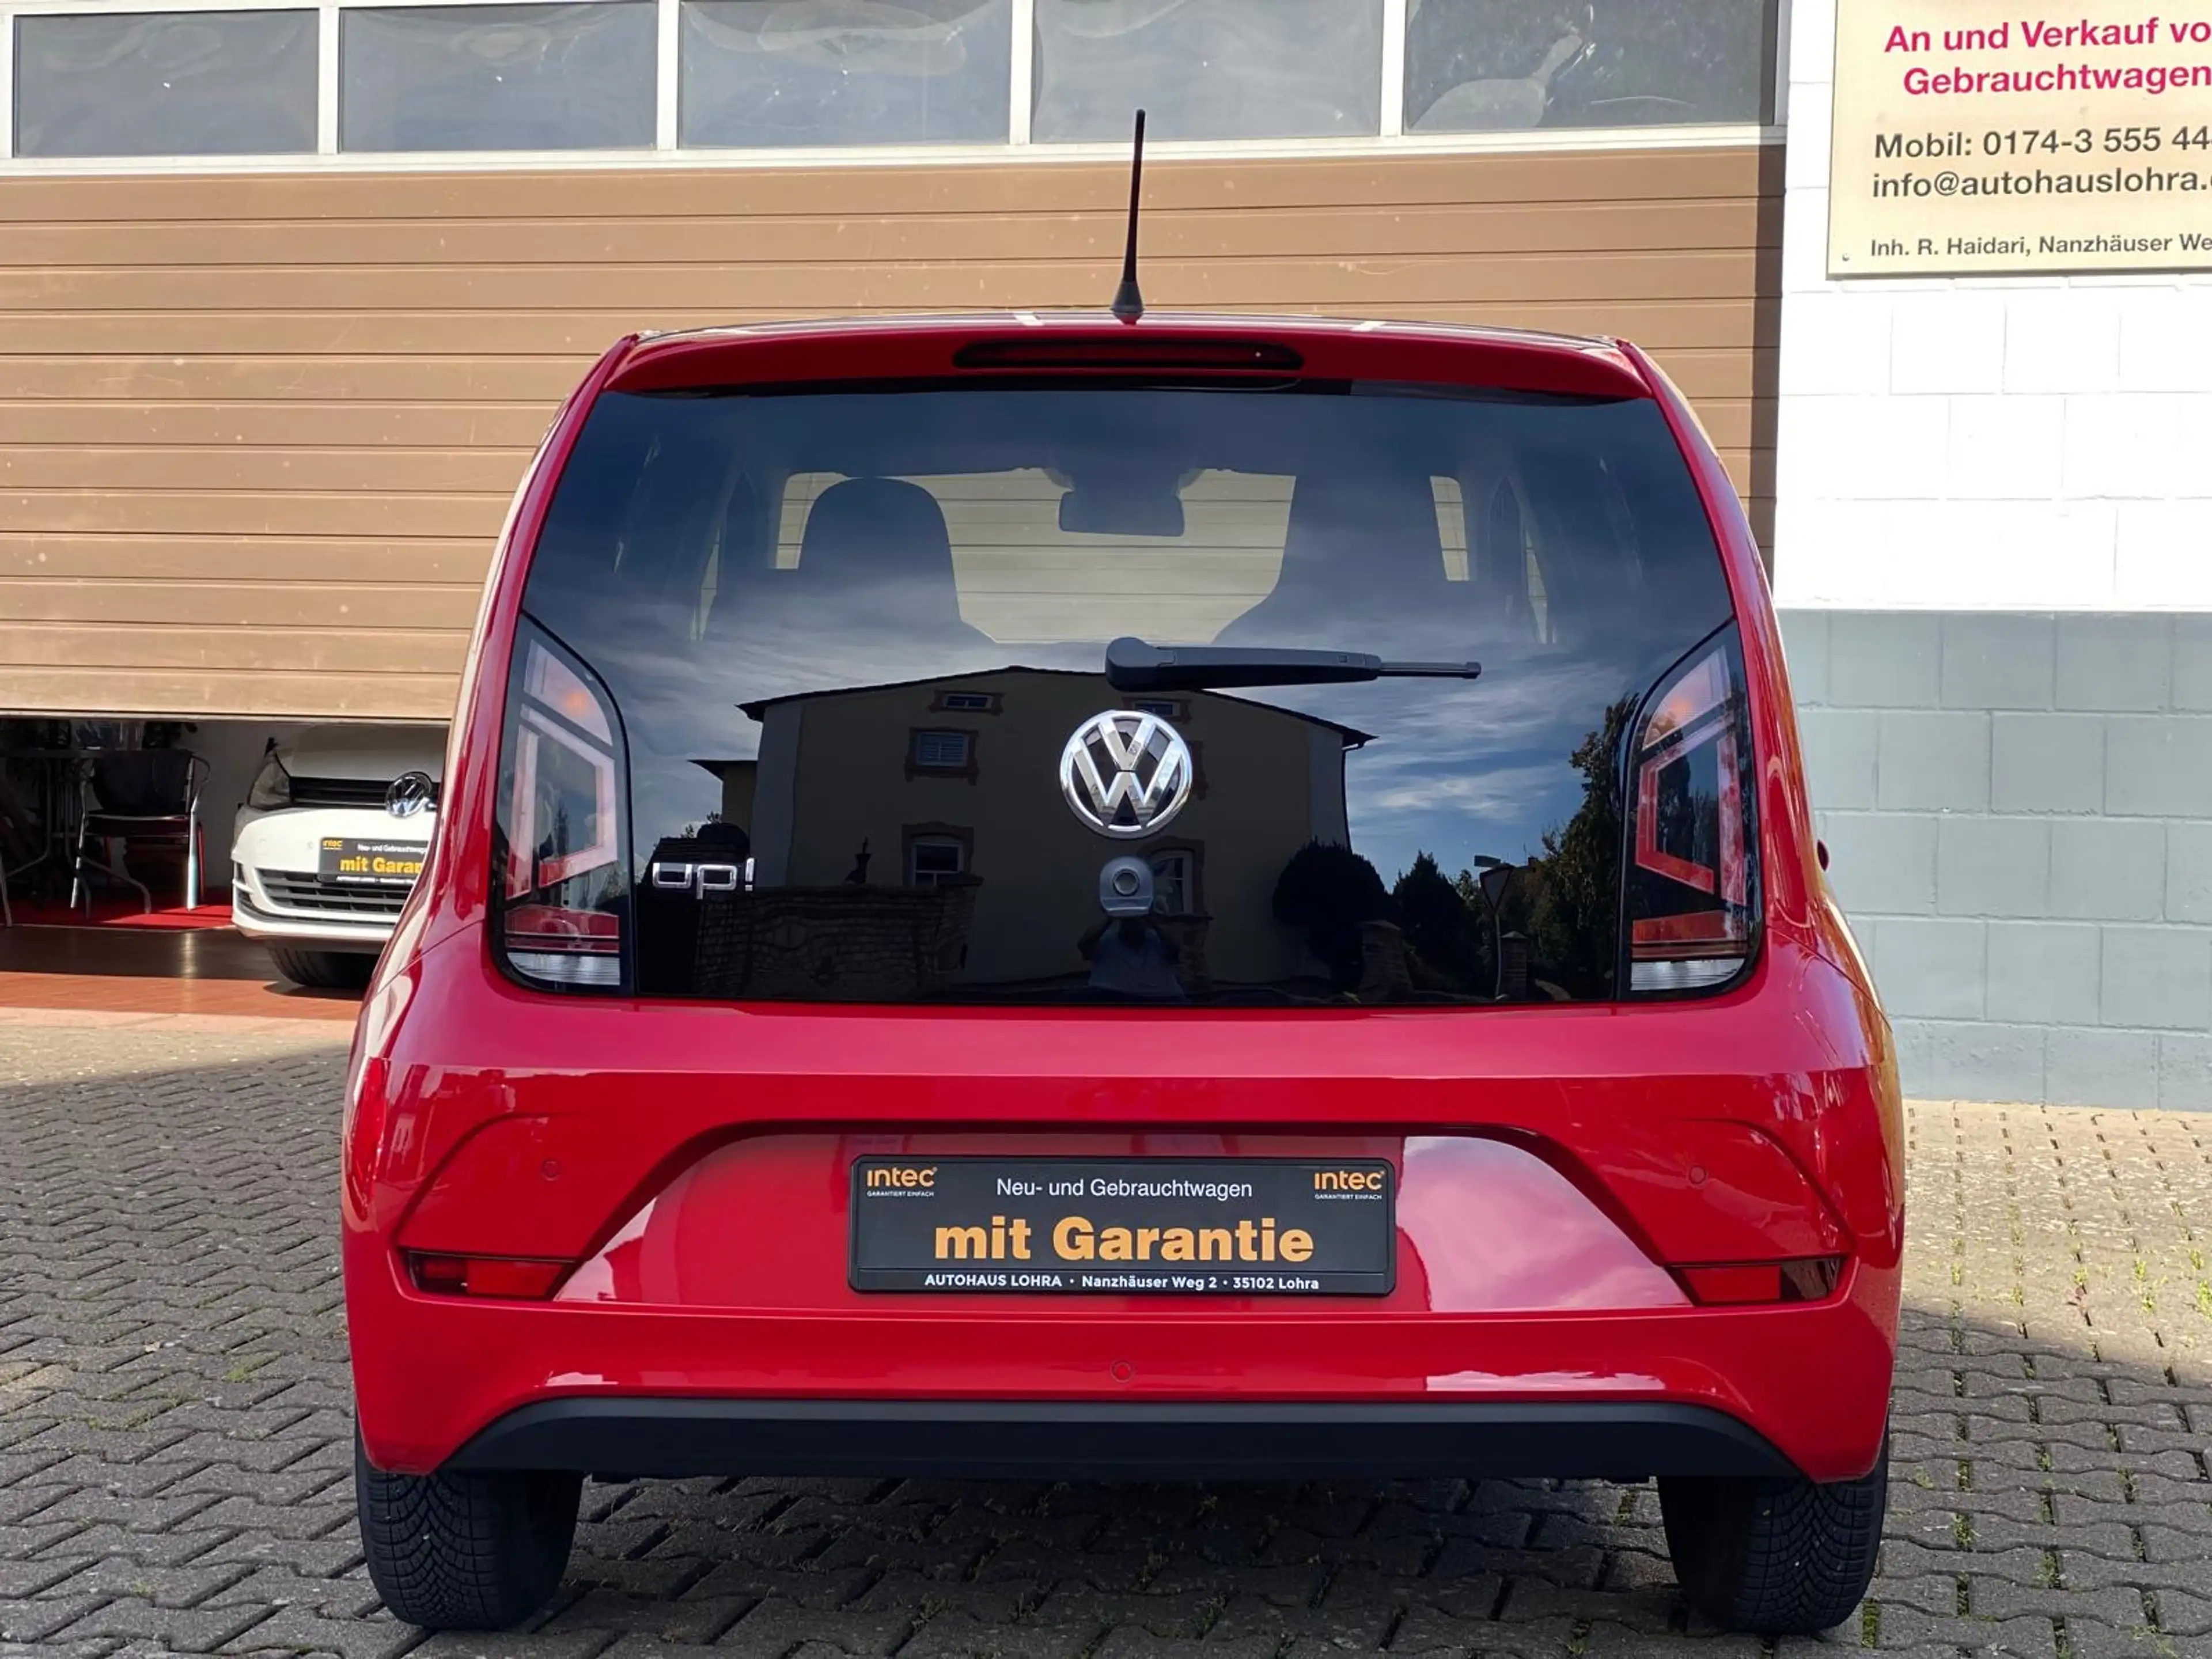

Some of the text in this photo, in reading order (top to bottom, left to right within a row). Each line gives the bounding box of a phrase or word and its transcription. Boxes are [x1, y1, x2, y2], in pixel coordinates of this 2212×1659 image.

[1884, 25, 1931, 52] An
[1944, 22, 2009, 51] und
[2021, 17, 2159, 48] Verkauf
[1903, 63, 2212, 95] Gebrauchtwagen
[1875, 126, 2212, 158] Mobil: 0174-3 555 44
[1873, 166, 2212, 198] info@autohauslohra.
[1871, 238, 1910, 256] Inh.
[1917, 238, 1938, 255] R.
[1947, 236, 2031, 257] Haidari,
[2039, 234, 2173, 253] Nanzhäuser
[1062, 711, 1191, 838] VW
[339, 855, 369, 872] mit
[653, 857, 755, 900] up!
[997, 1178, 1253, 1201] Neu- und Gebrauchtwagen
[935, 1215, 1314, 1262] mit Garantie
[925, 1274, 1320, 1291] AUTOHAUS LOHRA Nanzhäuser Weg 2 35102 Lohra
